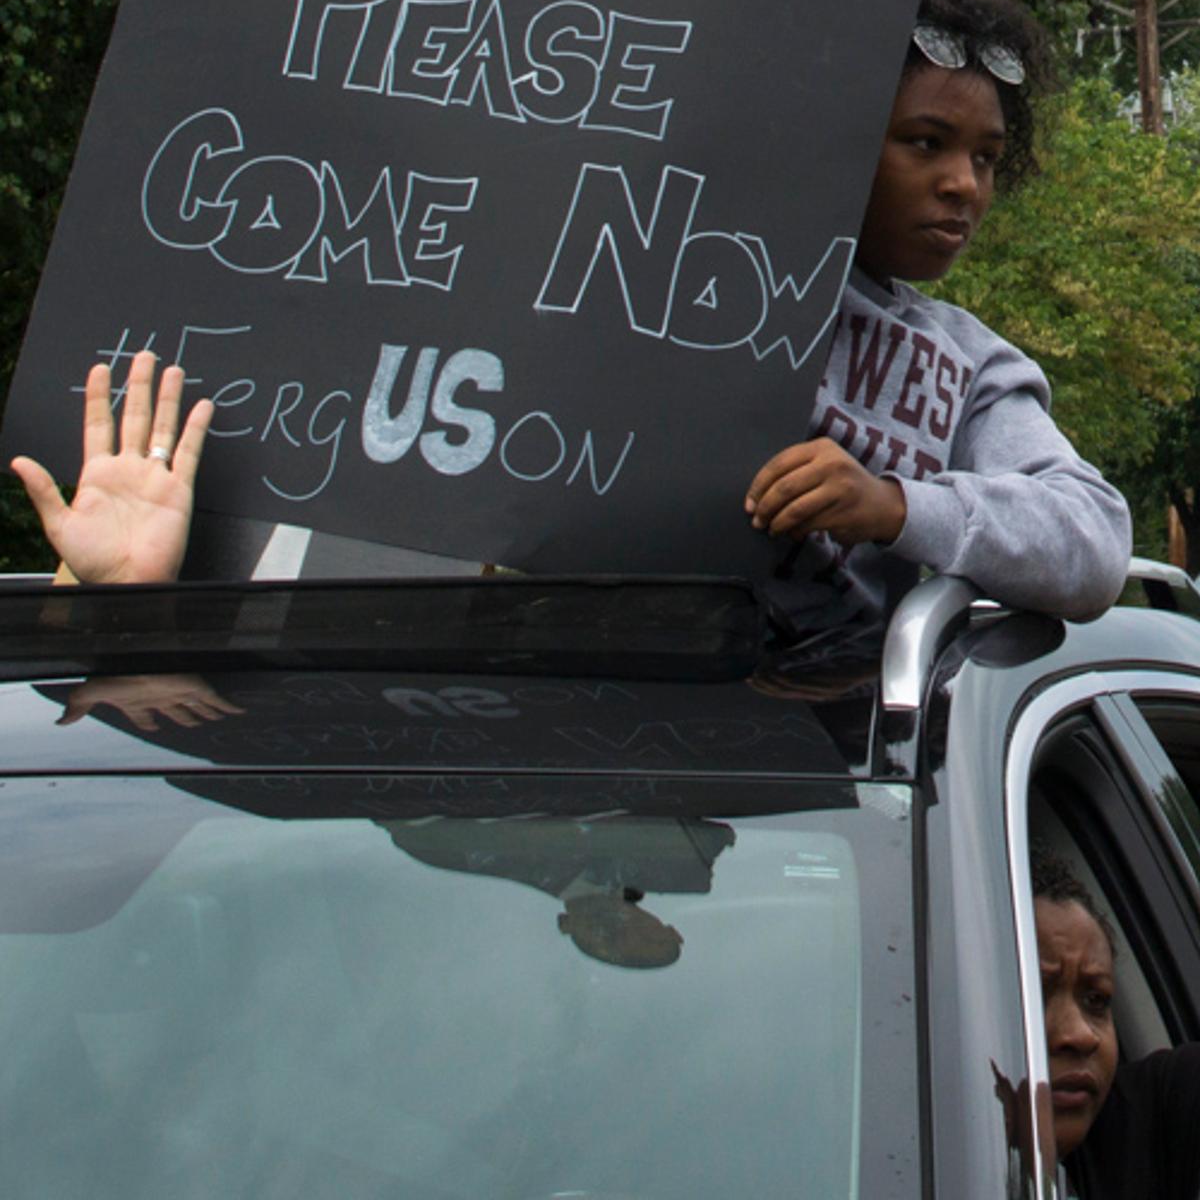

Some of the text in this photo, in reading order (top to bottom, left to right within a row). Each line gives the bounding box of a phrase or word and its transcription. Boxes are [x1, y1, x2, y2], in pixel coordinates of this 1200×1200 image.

[142, 107, 857, 369] COME NOW
[819, 310, 974, 442] WES
